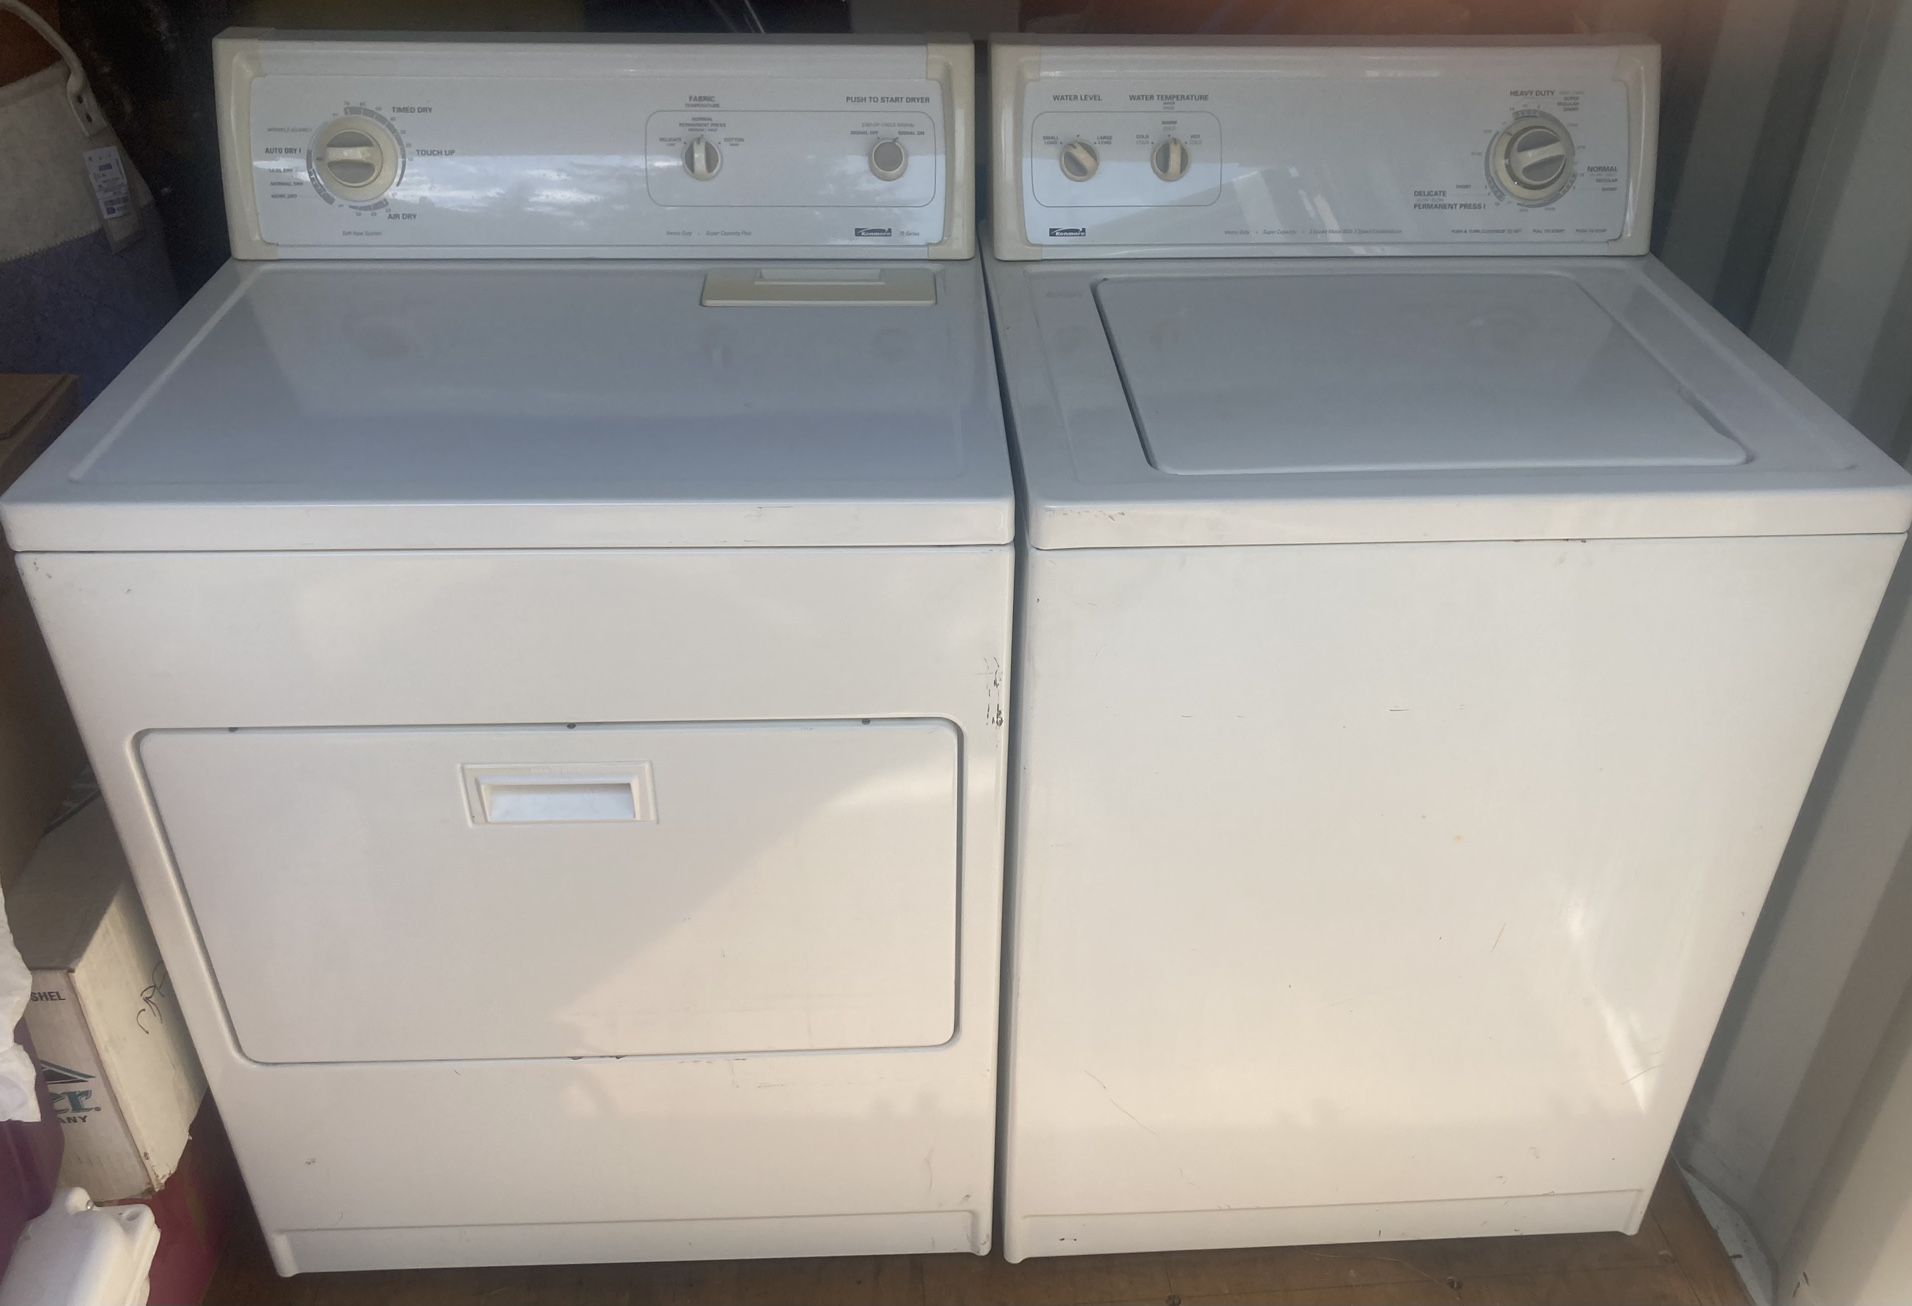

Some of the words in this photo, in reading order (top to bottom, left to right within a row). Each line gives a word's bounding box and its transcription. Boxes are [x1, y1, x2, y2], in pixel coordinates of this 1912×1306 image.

[880, 96, 904, 104] START
[906, 96, 930, 104] DRYER
[31, 991, 66, 1001] SHEL
